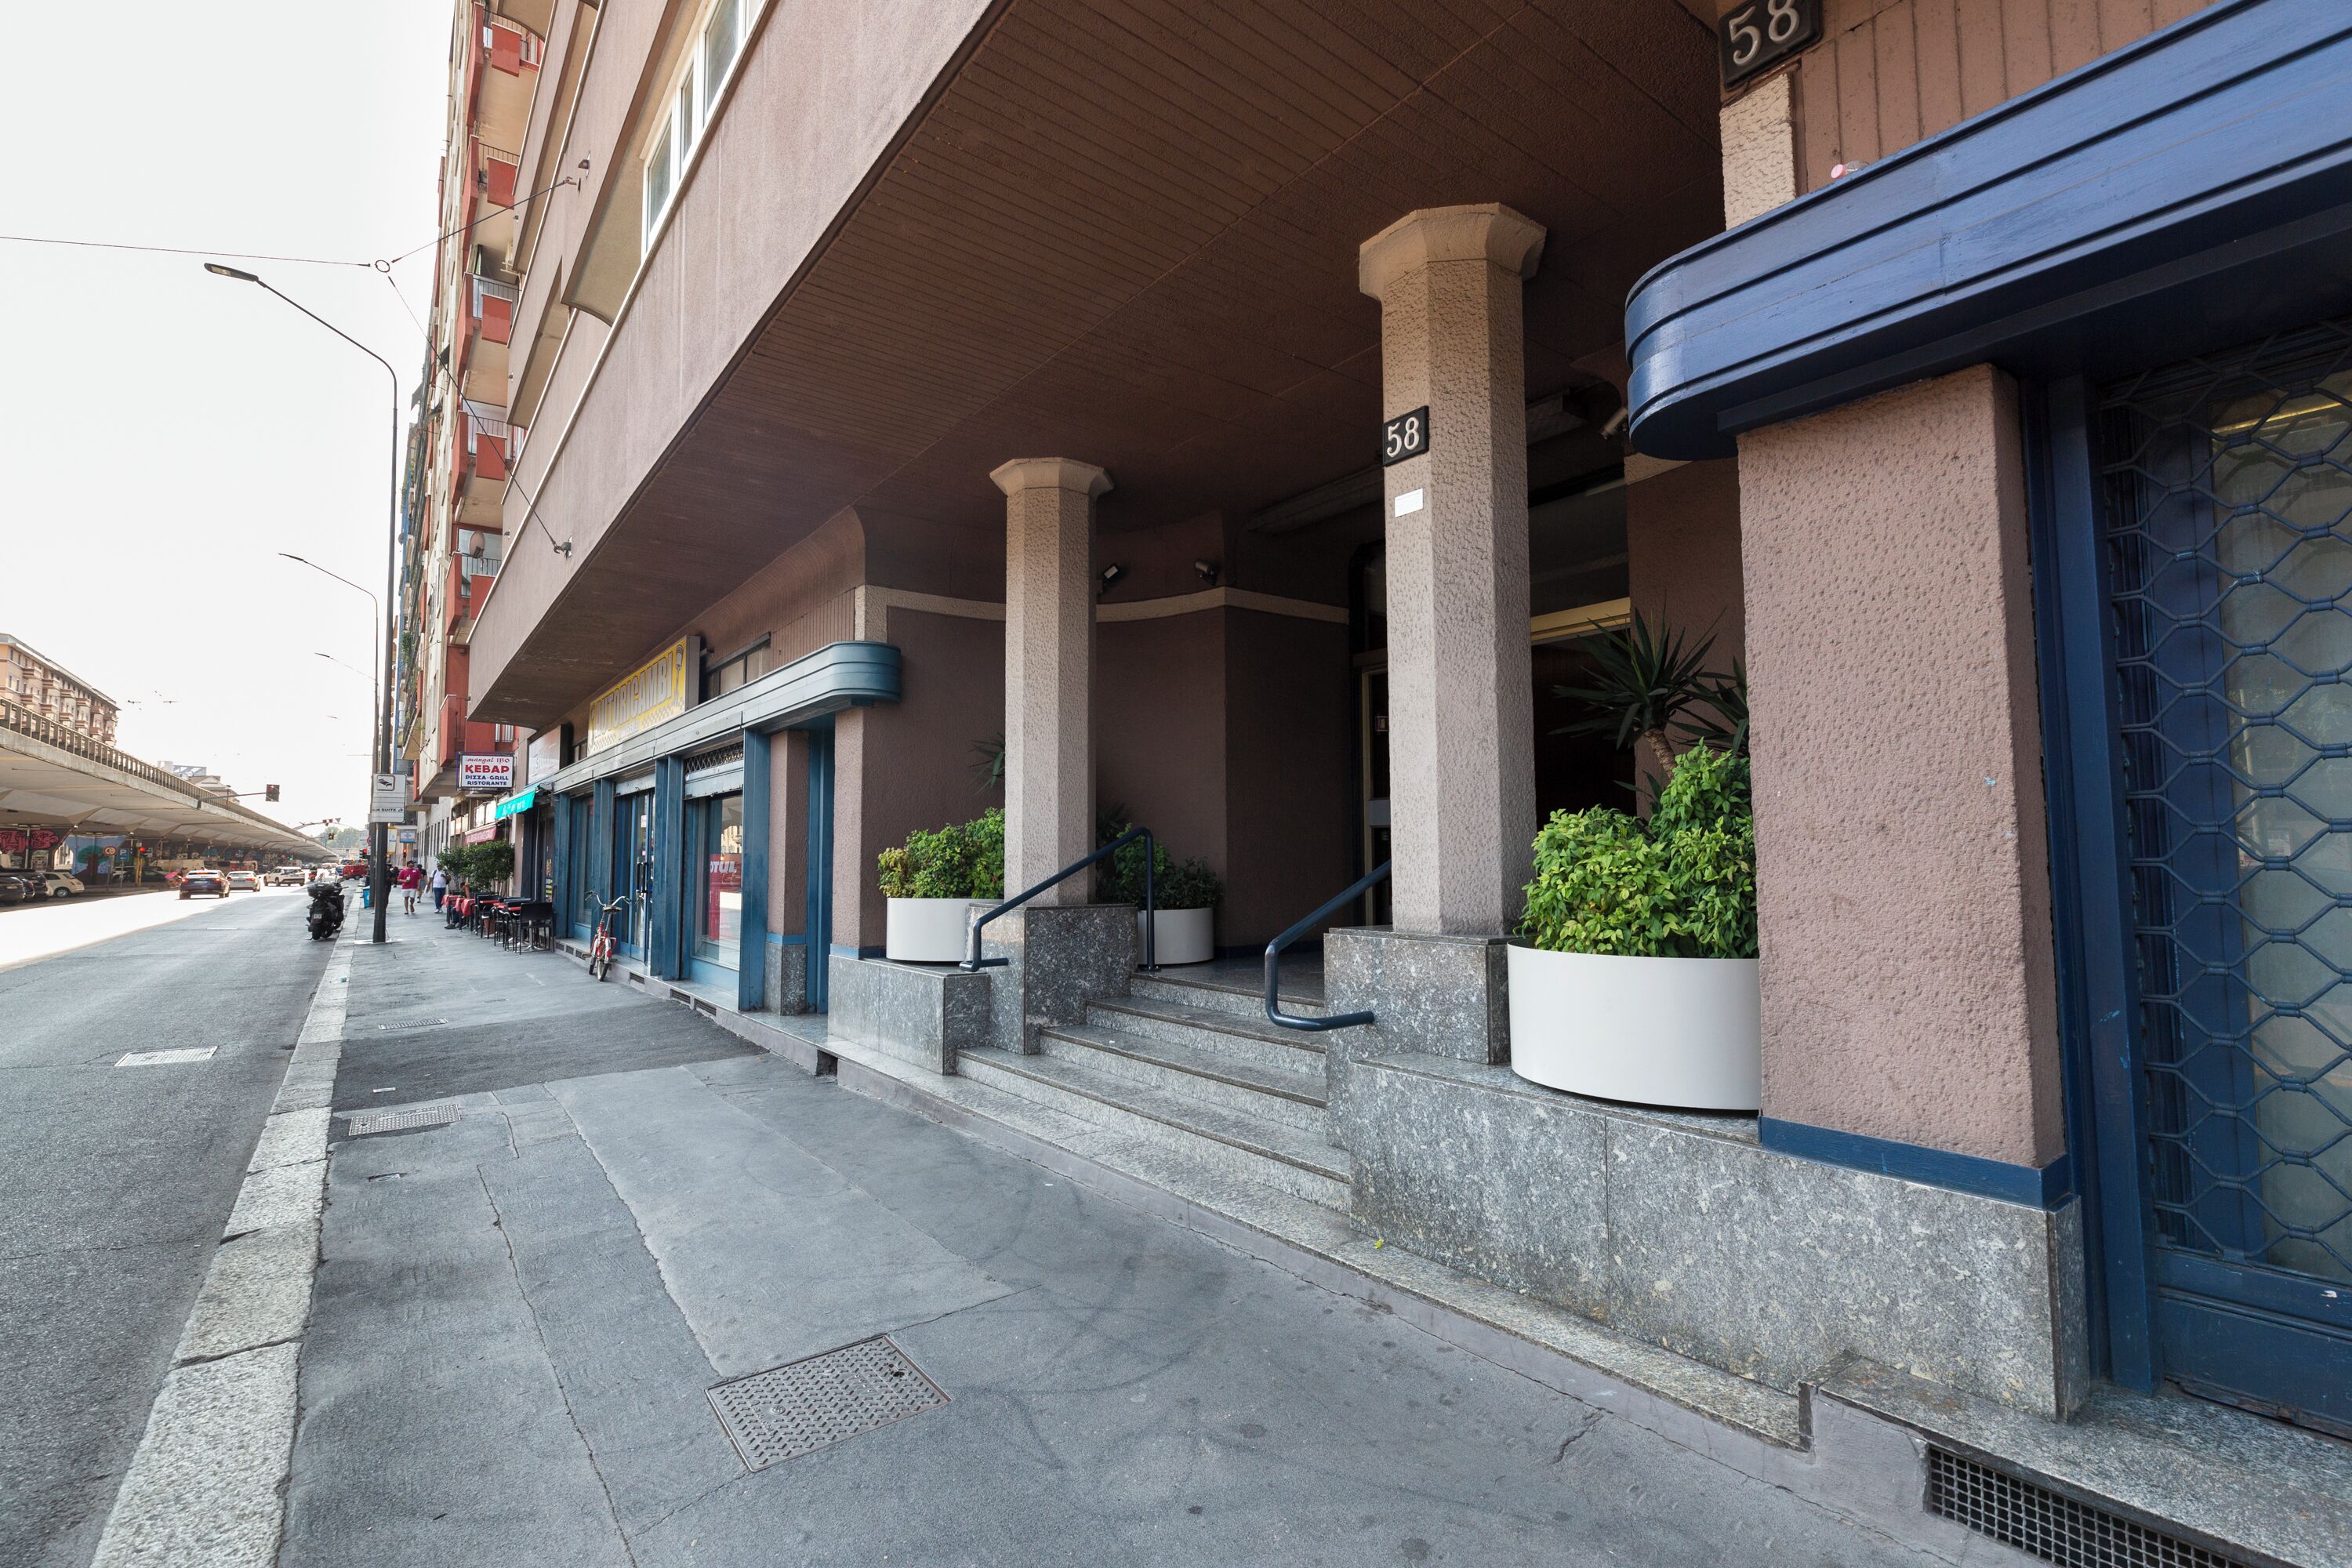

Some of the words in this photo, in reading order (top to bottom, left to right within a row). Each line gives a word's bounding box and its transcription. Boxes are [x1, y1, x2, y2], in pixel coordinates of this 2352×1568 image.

[1729, 0, 1799, 66] 58
[1387, 416, 1420, 457] 58
[594, 652, 673, 738] AUTORICAMBI
[465, 764, 510, 774] KEBAP
[710, 861, 737, 873] TUL
